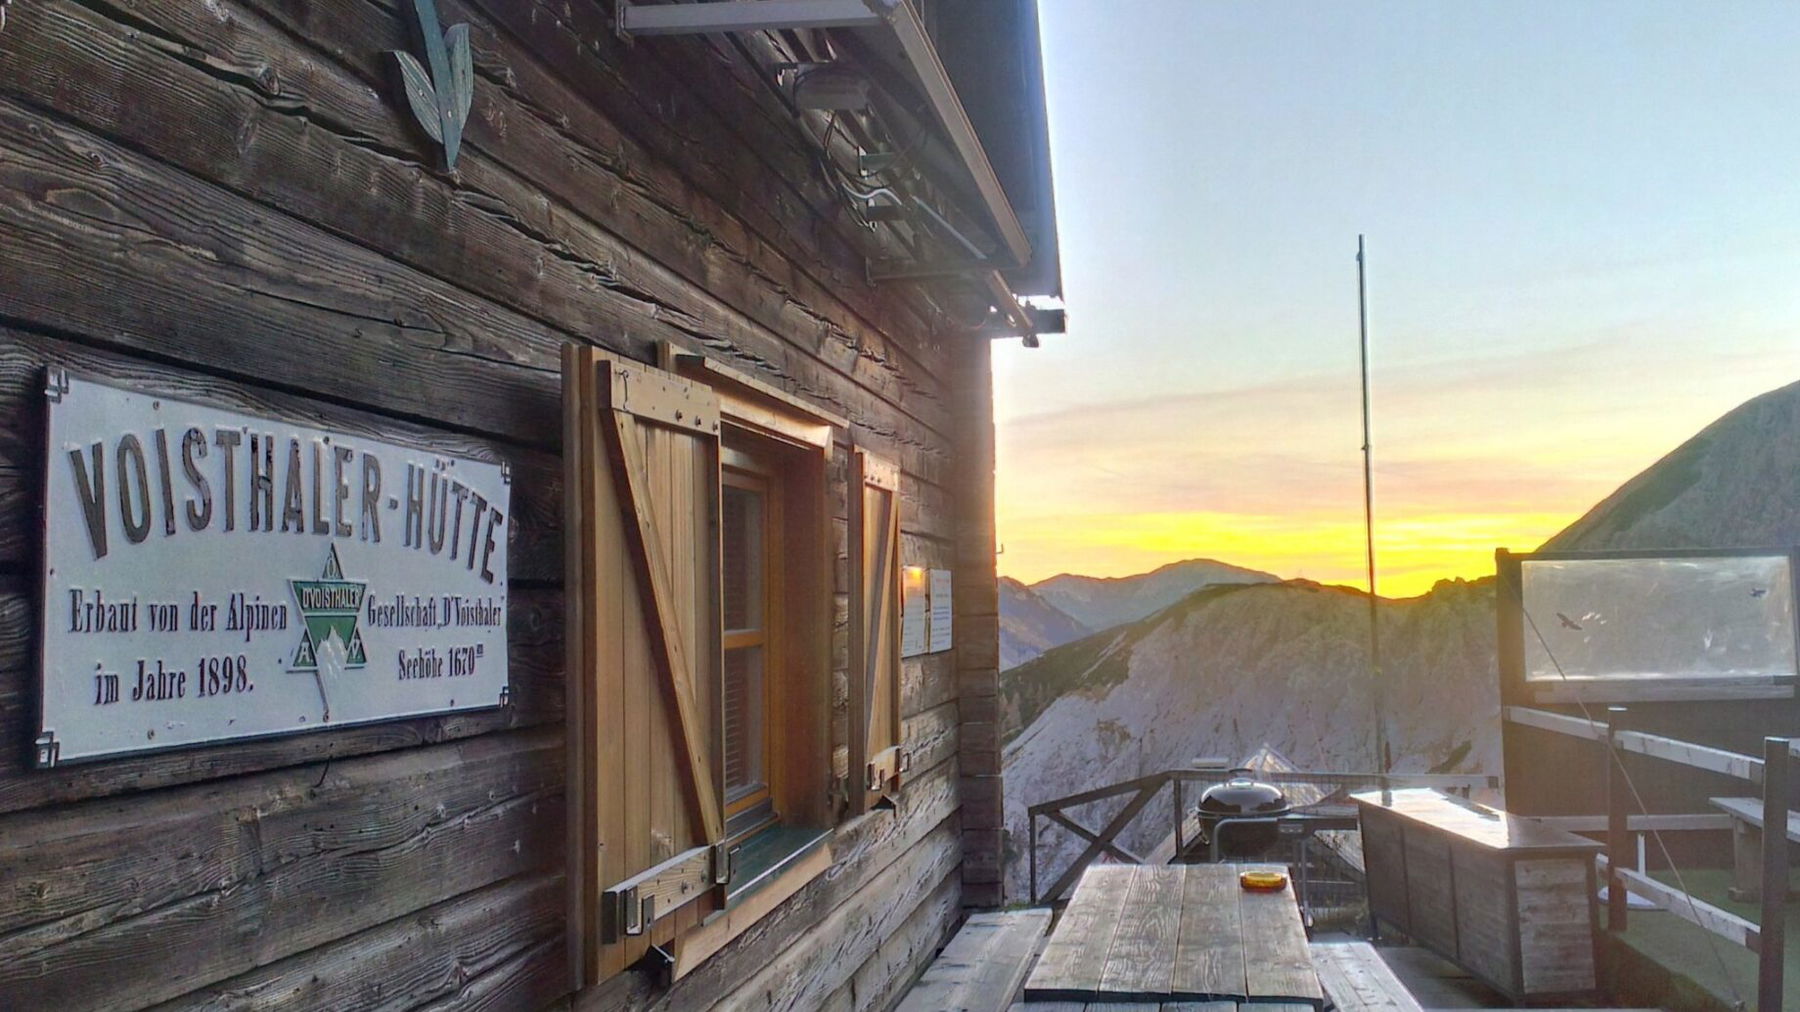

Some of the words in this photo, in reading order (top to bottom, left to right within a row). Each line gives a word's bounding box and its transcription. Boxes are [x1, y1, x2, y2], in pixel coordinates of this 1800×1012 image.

[69, 427, 504, 585] VOISTHALER-HÜTTE
[69, 589, 138, 633] Erbaut
[148, 603, 179, 632] von
[190, 591, 217, 631] der
[226, 592, 288, 642] Alpinen
[367, 594, 436, 628] Gesellschaft
[94, 662, 120, 705] im
[132, 660, 186, 701] Jahre
[198, 655, 254, 699] 1898.
[398, 647, 443, 681] Seehöhe
